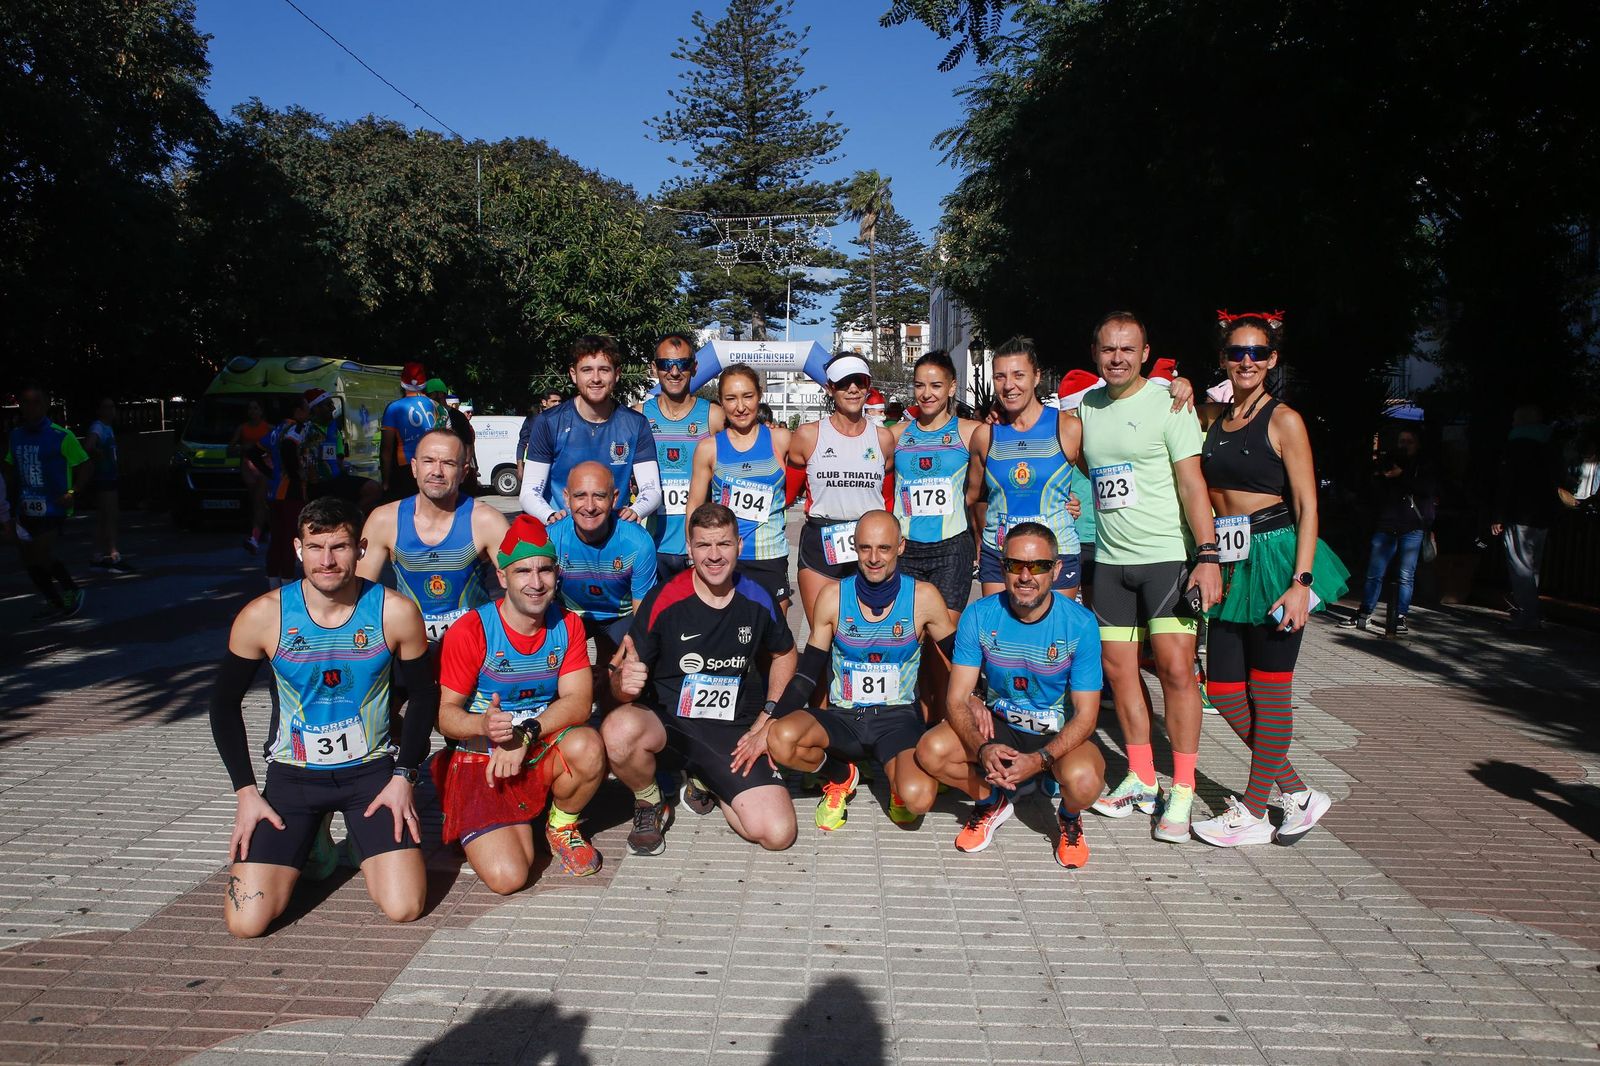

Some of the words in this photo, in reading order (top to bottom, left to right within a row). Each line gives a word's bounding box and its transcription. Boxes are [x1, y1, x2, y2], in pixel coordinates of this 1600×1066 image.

[729, 352, 795, 363] CRONOFINISHER
[800, 394, 826, 404] TURIS
[816, 471, 840, 479] CLUB
[843, 471, 882, 481] TRIATLÓN
[1095, 465, 1131, 475] CARRERA
[735, 479, 773, 492] CARRERA
[826, 480, 876, 489] ALGECIRAS
[1098, 478, 1130, 499] 223
[733, 490, 765, 512] 194
[912, 489, 947, 507] 178
[1215, 516, 1249, 526] ARRERA
[836, 534, 856, 553] 19
[706, 655, 747, 672] Spotif
[854, 663, 899, 671] CARRERA
[700, 676, 739, 684] CARRERA
[862, 676, 886, 694] 81
[694, 689, 732, 709] 226
[1009, 705, 1056, 717] CARRERA
[293, 718, 302, 728] III
[305, 715, 361, 731] CARRERA
[1010, 714, 1050, 732] 217
[317, 732, 348, 755] 31
[1112, 793, 1144, 810] NITRO
